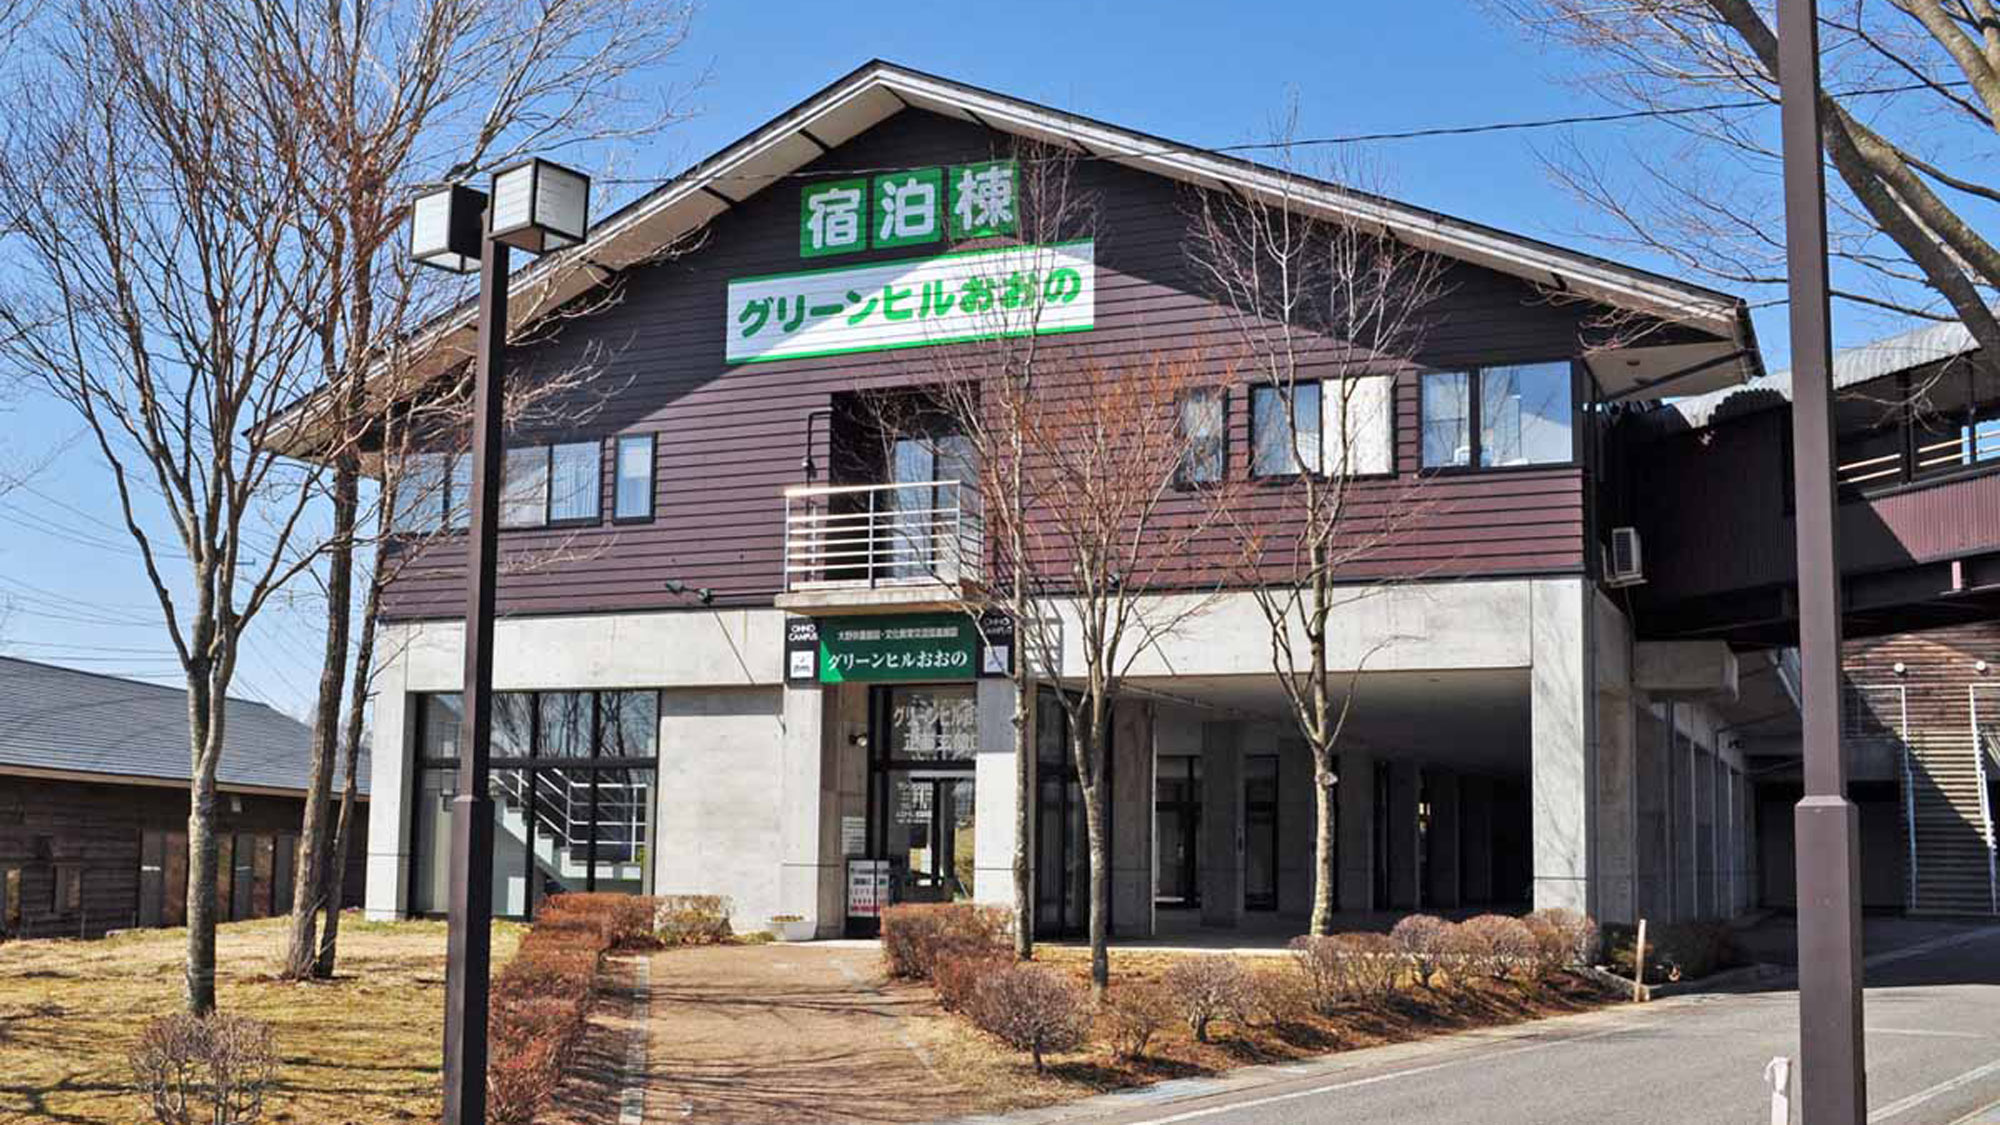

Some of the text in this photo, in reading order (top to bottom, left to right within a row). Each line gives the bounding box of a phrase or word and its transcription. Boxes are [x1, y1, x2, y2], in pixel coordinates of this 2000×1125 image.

[807, 165, 1014, 249] 宿泊棟
[739, 267, 1082, 338] グリーンヒルおおの
[828, 649, 968, 671] グリーンヒルおおの
